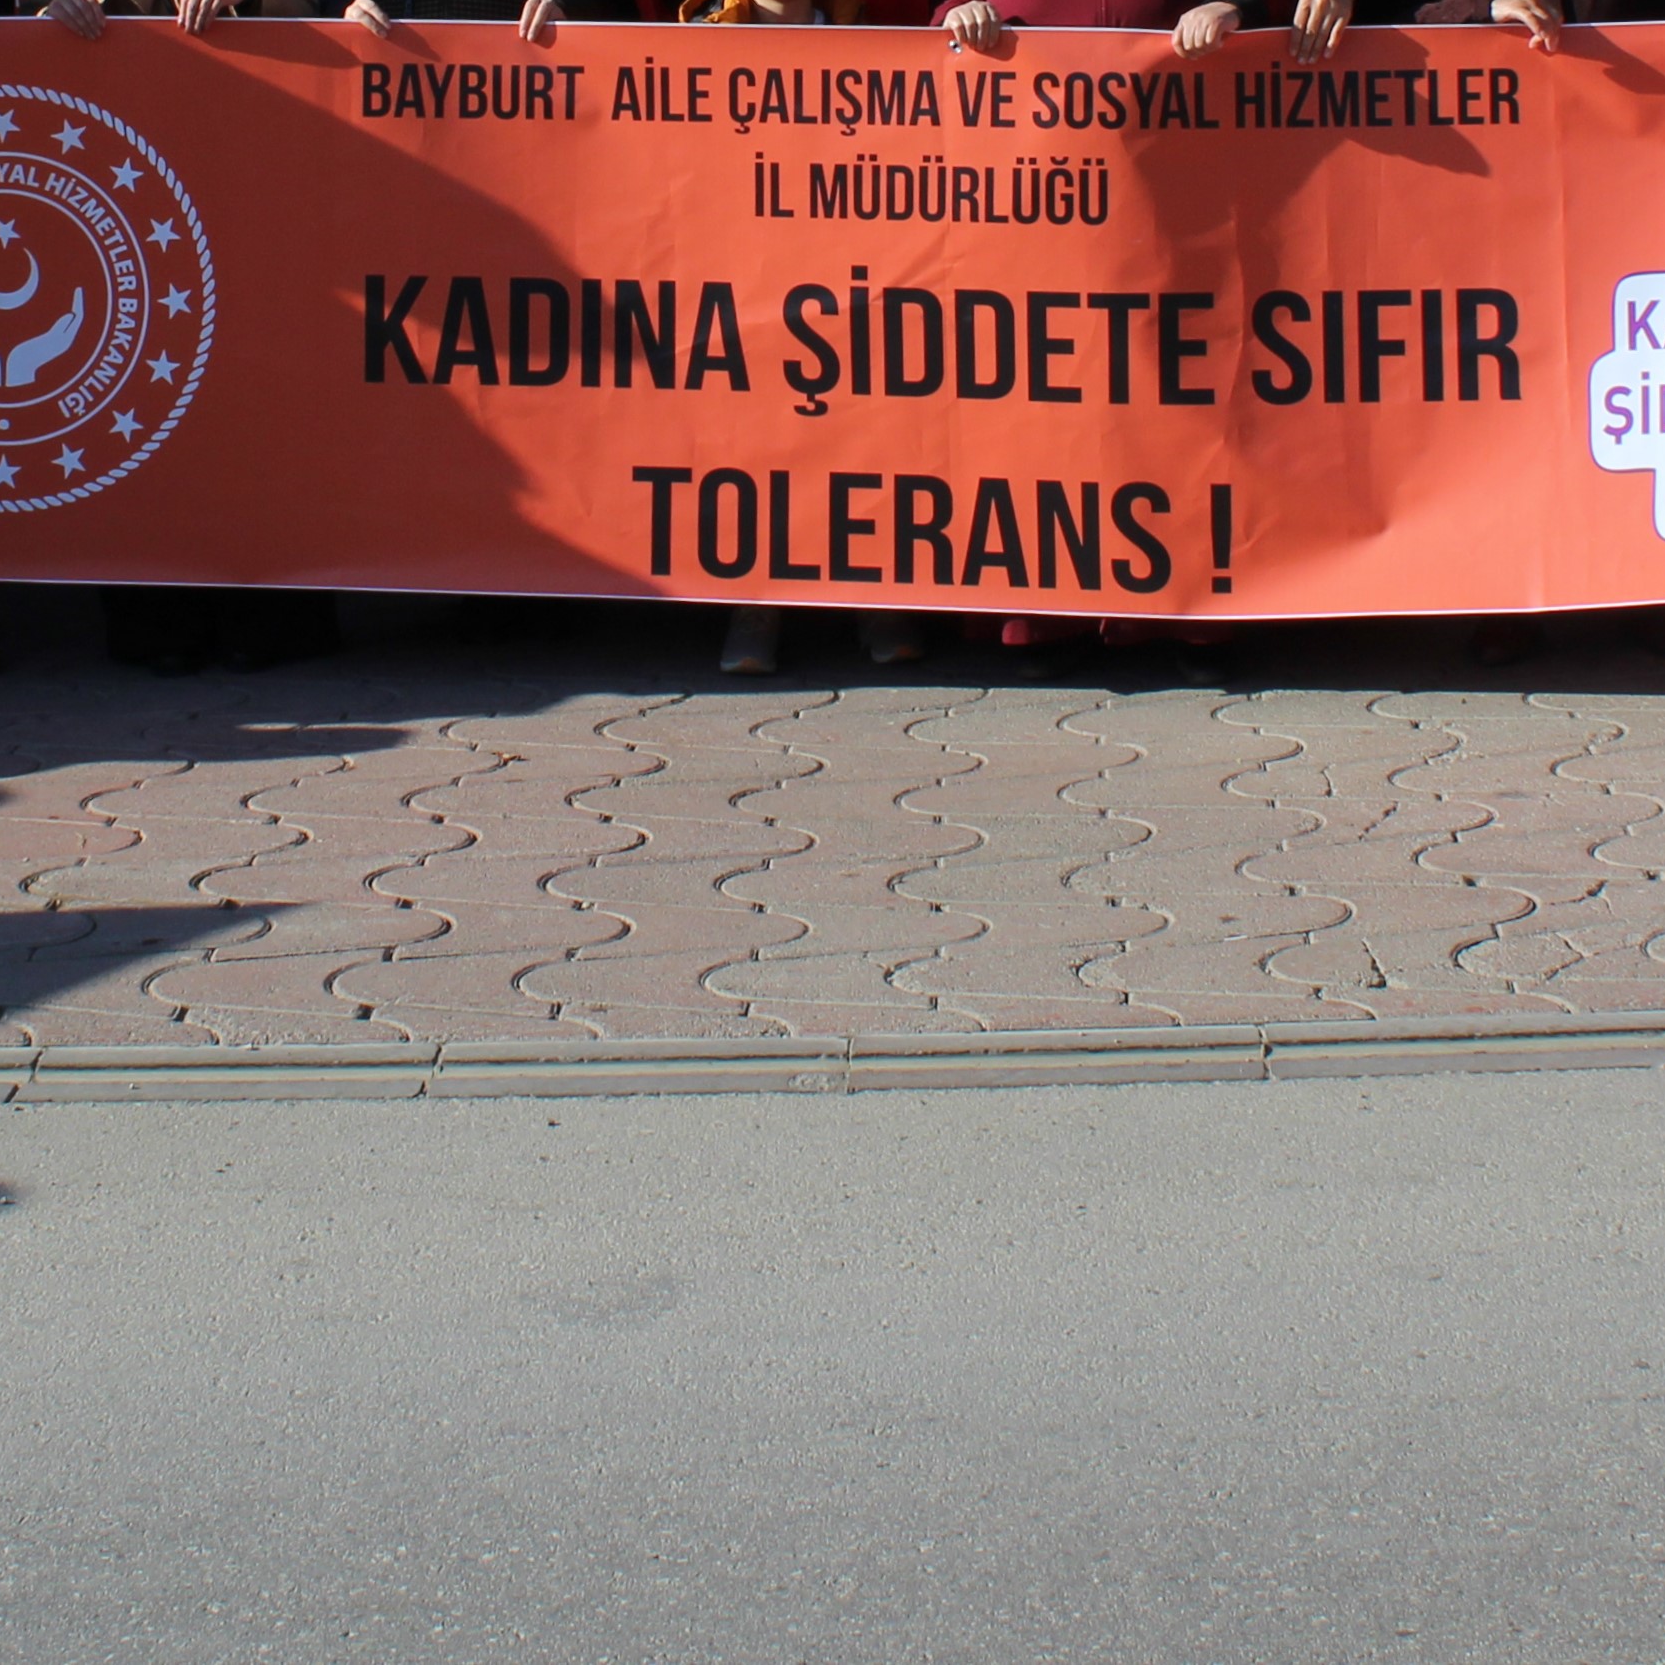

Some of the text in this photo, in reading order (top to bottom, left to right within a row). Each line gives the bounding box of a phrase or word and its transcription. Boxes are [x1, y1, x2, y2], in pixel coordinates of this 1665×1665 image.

[362, 56, 1521, 136] BAYBURT AİLE ÇALIŞMA VE SOSYAL HİZMETLER
[45, 172, 136, 292] HİZMETLER
[754, 151, 1109, 226] İL MÜDÜRLÜĞÜ
[57, 298, 138, 418] BAKANLIĞI
[364, 265, 1522, 417] KADINA ŞİDDETE SIFIR
[632, 465, 1233, 594] TOLERANS !
